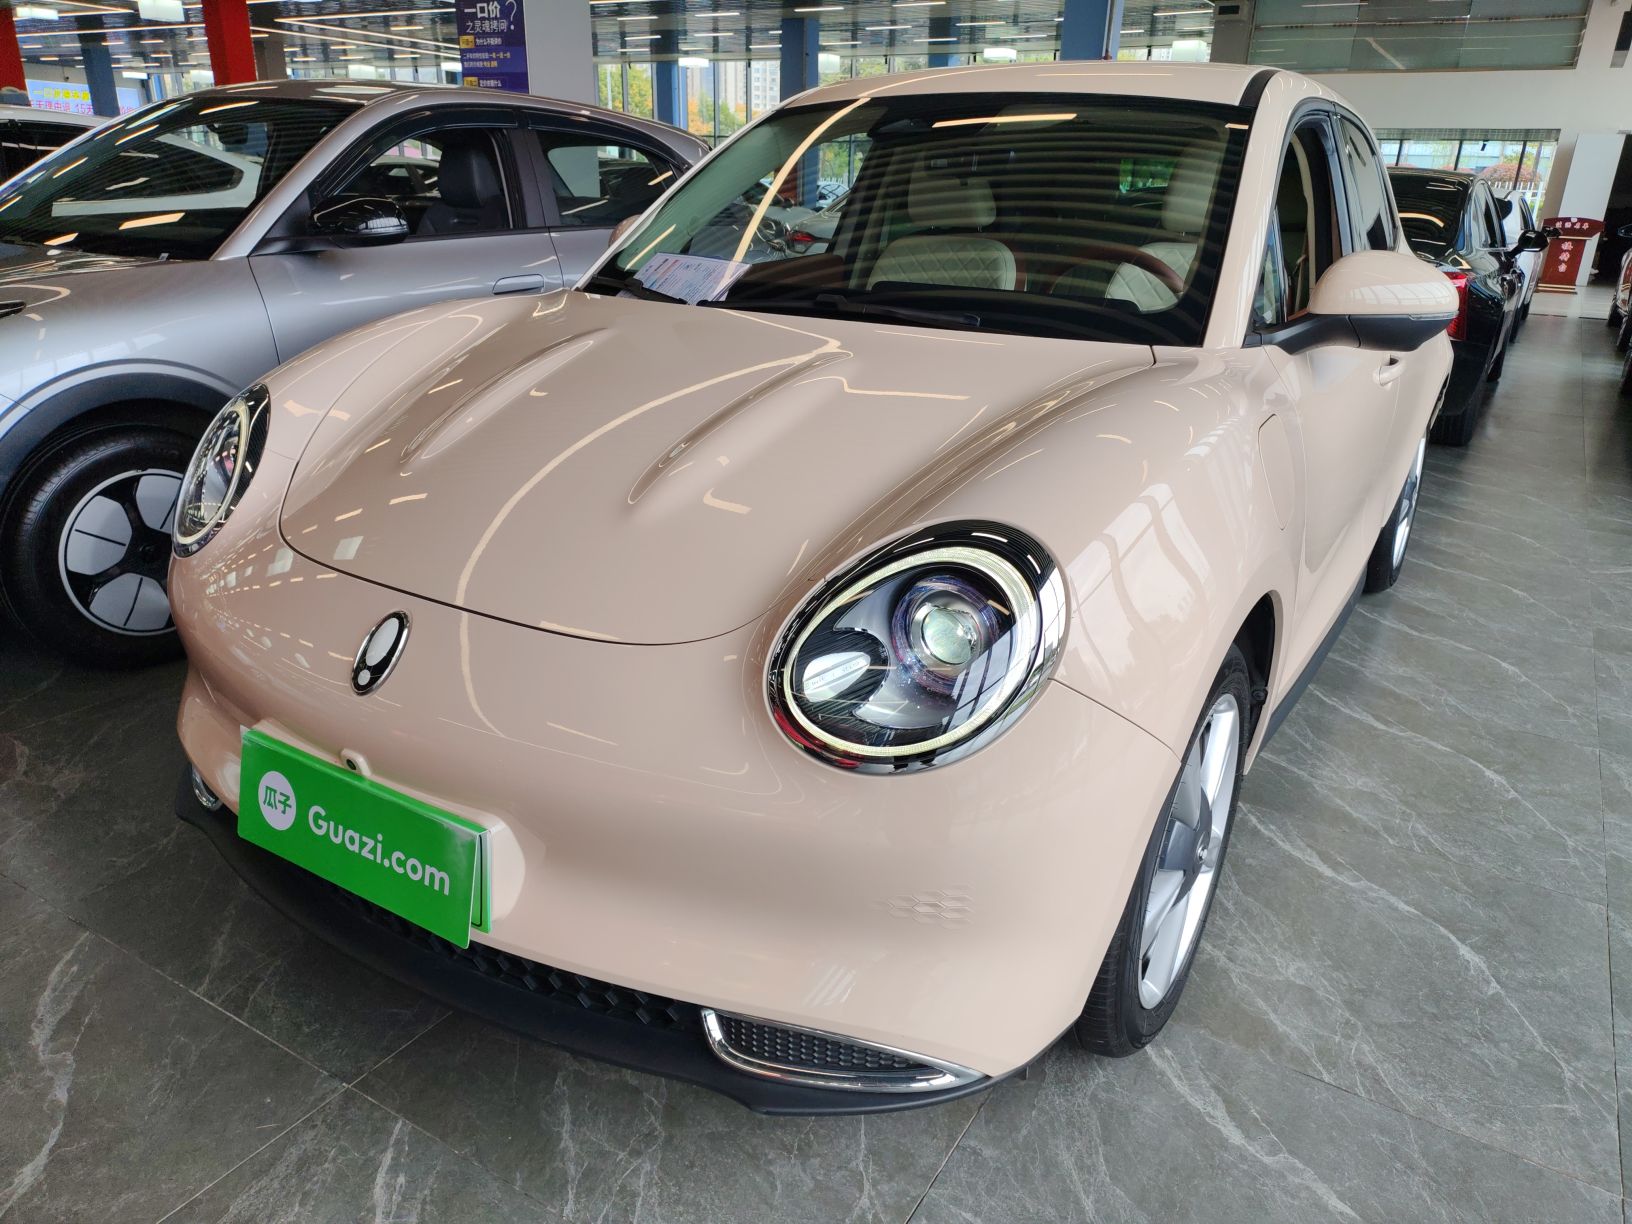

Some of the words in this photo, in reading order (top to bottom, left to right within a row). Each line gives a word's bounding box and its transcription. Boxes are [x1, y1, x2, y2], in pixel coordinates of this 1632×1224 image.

[464, 1, 500, 18] 一口价
[466, 19, 507, 33] 之灵魂拷问
[262, 785, 292, 815] 瓜子
[308, 805, 450, 896] Guazi.com
